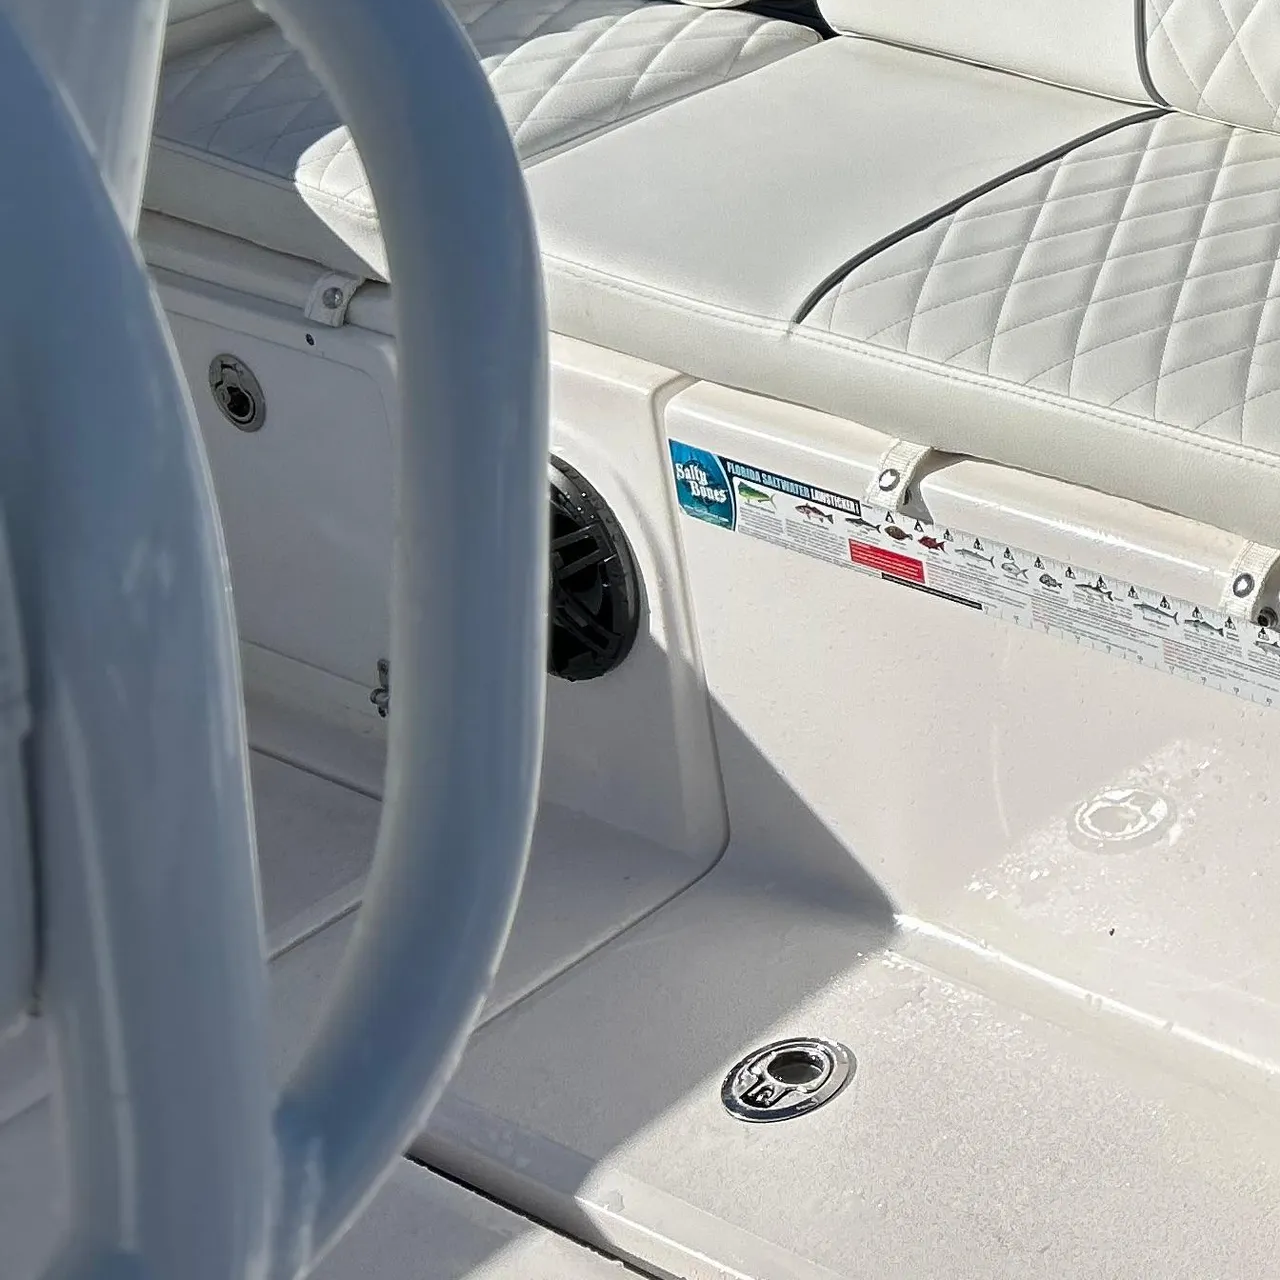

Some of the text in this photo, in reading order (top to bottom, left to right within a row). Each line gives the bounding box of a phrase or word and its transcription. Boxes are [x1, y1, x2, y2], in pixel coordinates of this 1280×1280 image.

[675, 463, 708, 486] Salty
[726, 461, 761, 483] FLORIDA
[762, 473, 810, 498] SALTWATER
[687, 481, 727, 504] Bones
